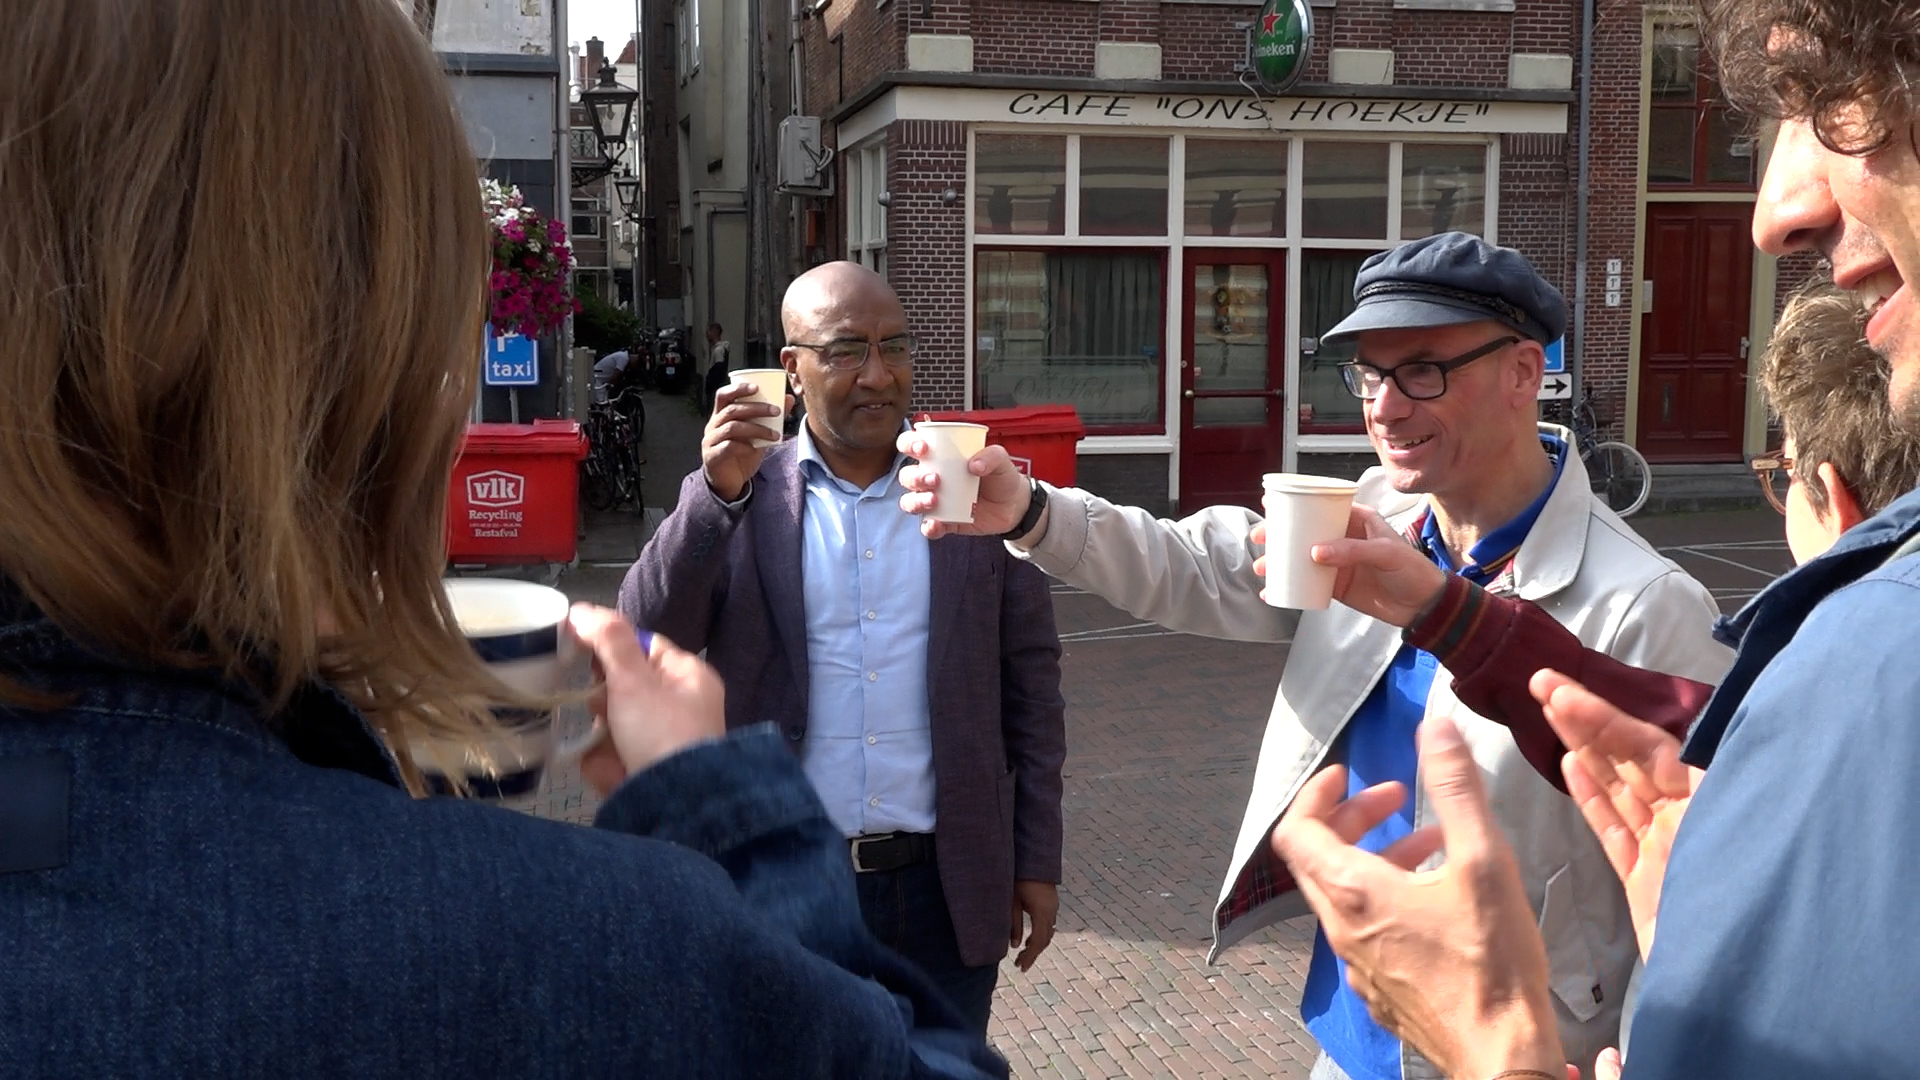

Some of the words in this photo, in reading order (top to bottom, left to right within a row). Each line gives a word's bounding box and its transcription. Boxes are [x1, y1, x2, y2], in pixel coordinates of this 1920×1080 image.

[1008, 92, 1136, 118] CAFE
[1289, 100, 1490, 124] HOEKJE"
[492, 360, 531, 377] taxi
[473, 477, 517, 499] vlk
[468, 509, 523, 522] Recycling
[475, 528, 518, 538] Restafval
